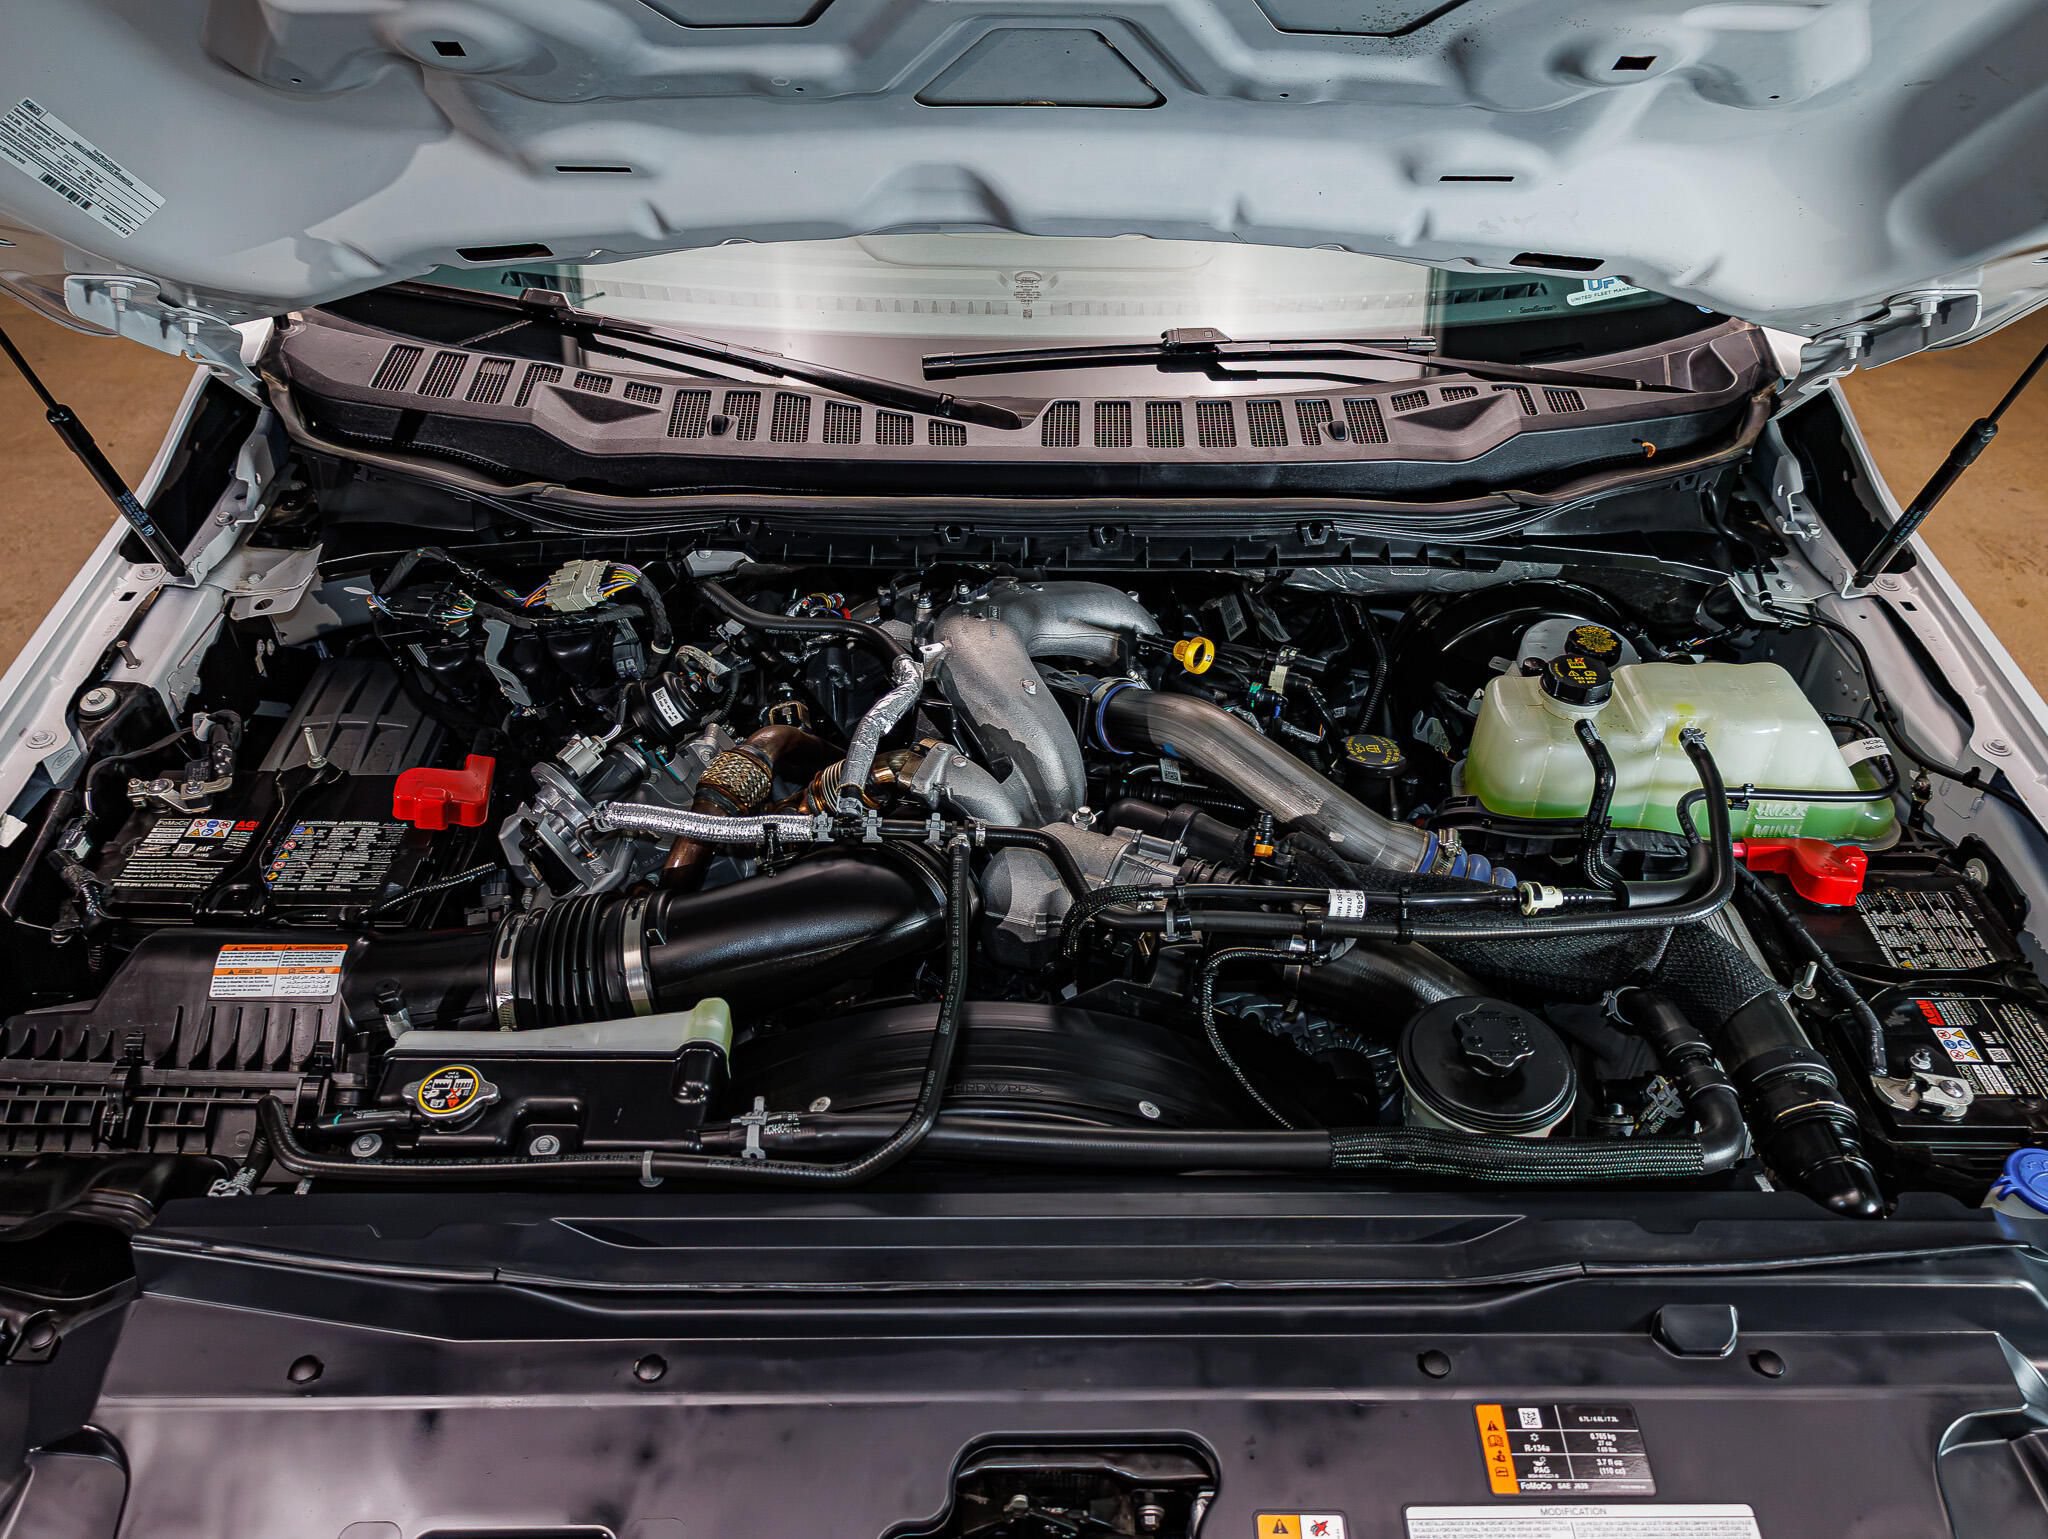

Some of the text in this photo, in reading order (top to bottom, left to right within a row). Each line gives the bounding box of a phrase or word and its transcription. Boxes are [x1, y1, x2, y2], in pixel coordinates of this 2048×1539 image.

[1570, 294, 1592, 302] UNITED
[1959, 1066, 1980, 1095] FoMoCo
[1607, 1433, 1617, 1441] kg
[1524, 1444, 1550, 1452] R-134a
[1520, 1481, 1552, 1490] FoMoCo
[1540, 1507, 1607, 1516] MODIFICATION
